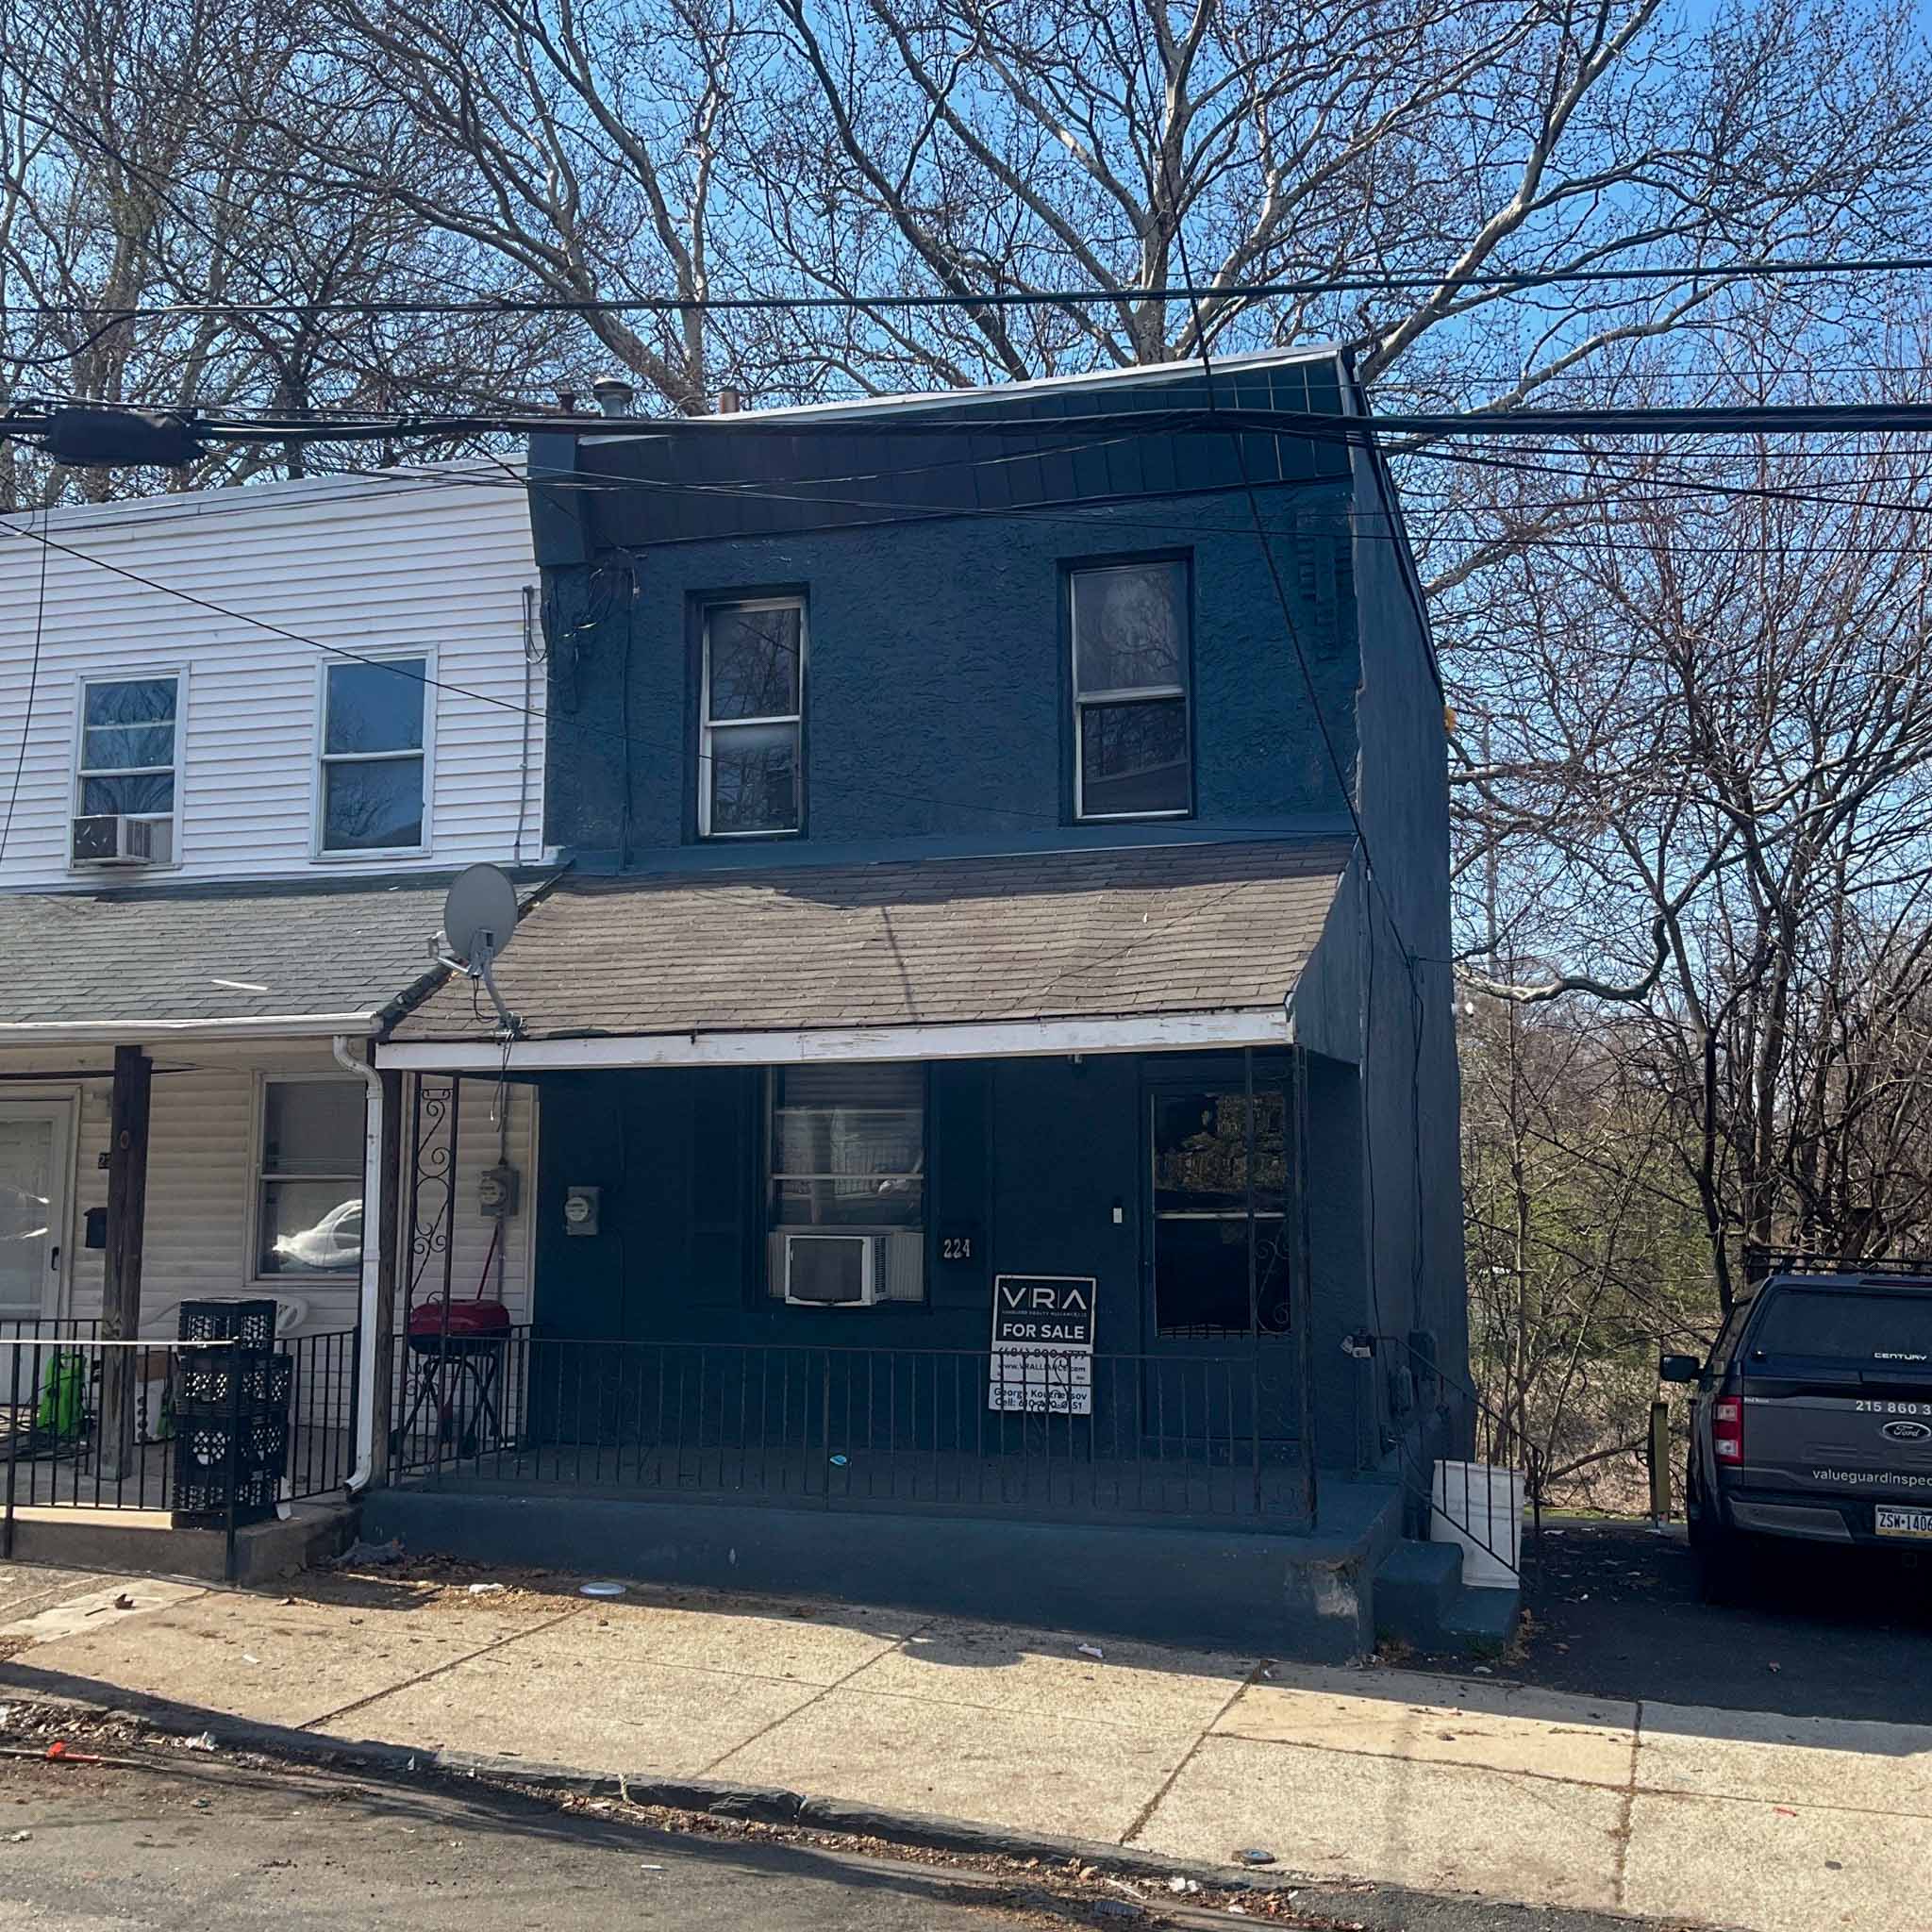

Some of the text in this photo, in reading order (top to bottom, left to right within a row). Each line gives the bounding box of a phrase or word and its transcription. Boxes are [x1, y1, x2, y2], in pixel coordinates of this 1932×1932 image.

[943, 1238, 971, 1259] 224
[1003, 1324, 1085, 1340] FOR SALE
[1874, 1352, 1928, 1361] CENTURY
[1856, 1400, 1882, 1413] 215
[1888, 1402, 1918, 1415] 860
[1893, 1424, 1921, 1438] Ford
[1812, 1469, 1932, 1488] valueguardinspec
